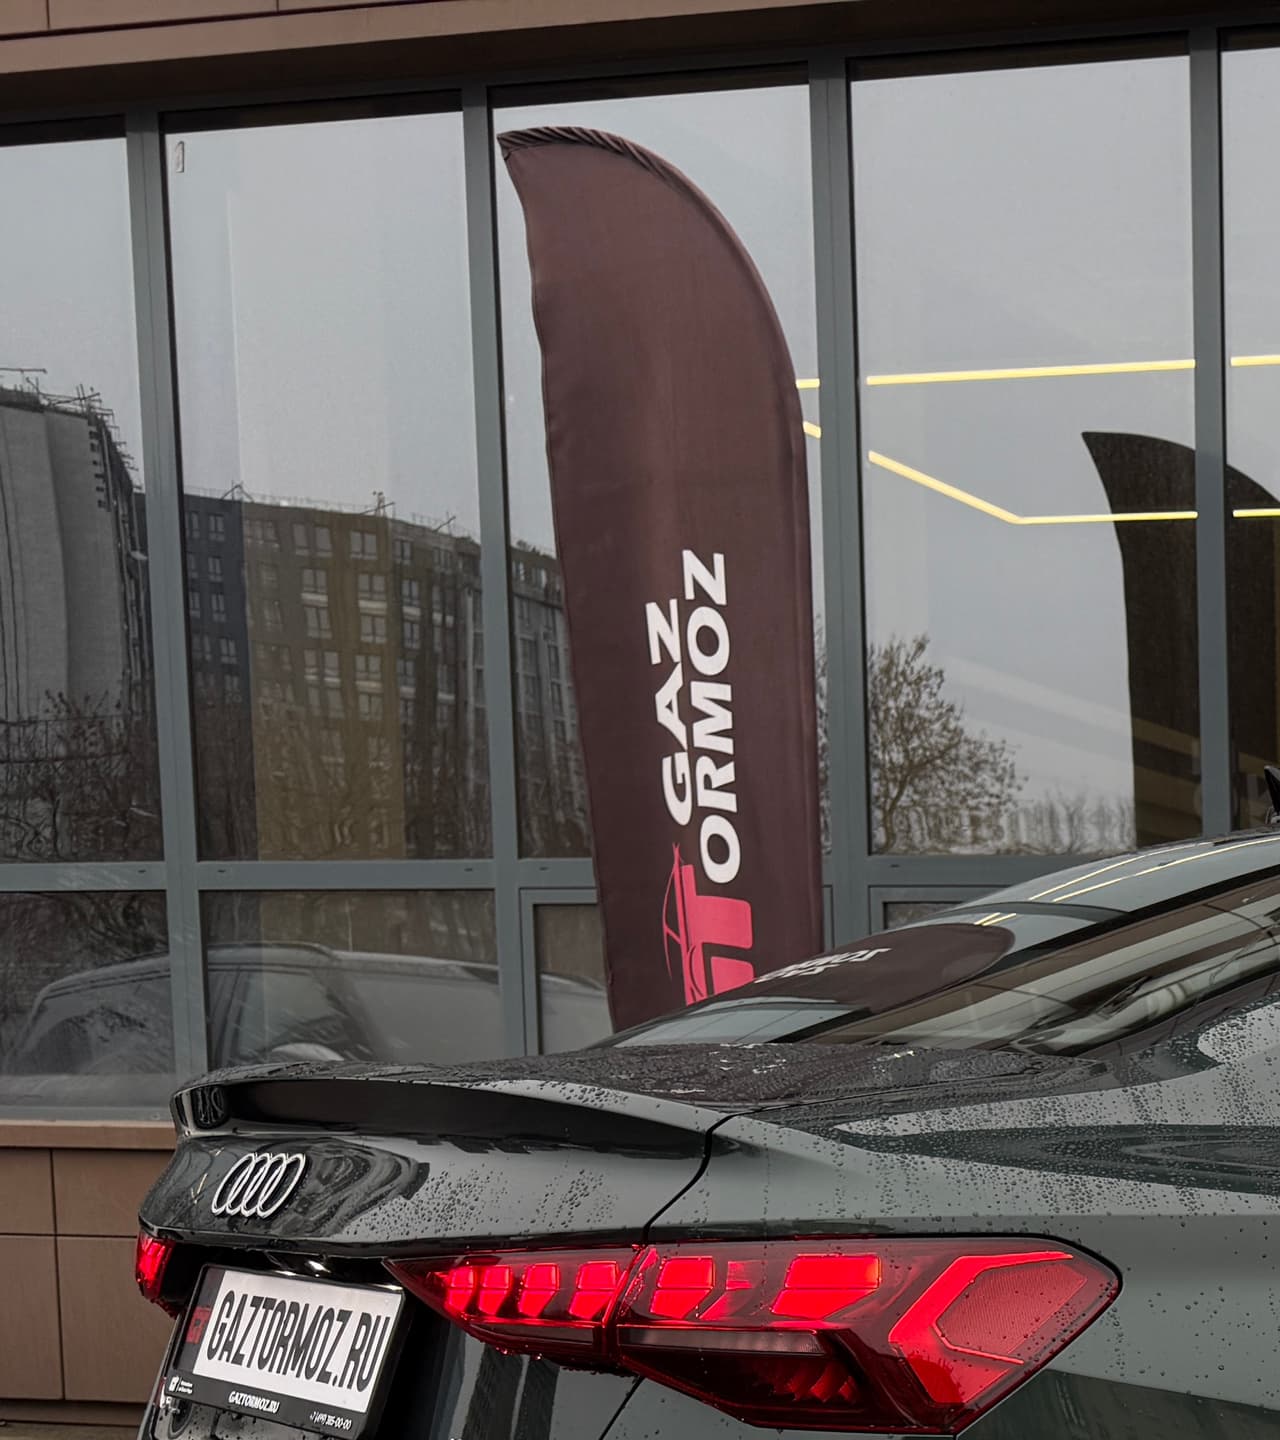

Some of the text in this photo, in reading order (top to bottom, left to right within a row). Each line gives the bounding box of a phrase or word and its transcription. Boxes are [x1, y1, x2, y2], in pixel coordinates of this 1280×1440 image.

[646, 598, 693, 827] GAZ
[682, 548, 741, 885] ORMOZ
[206, 1289, 391, 1393] GAZTORMOZ.RU
